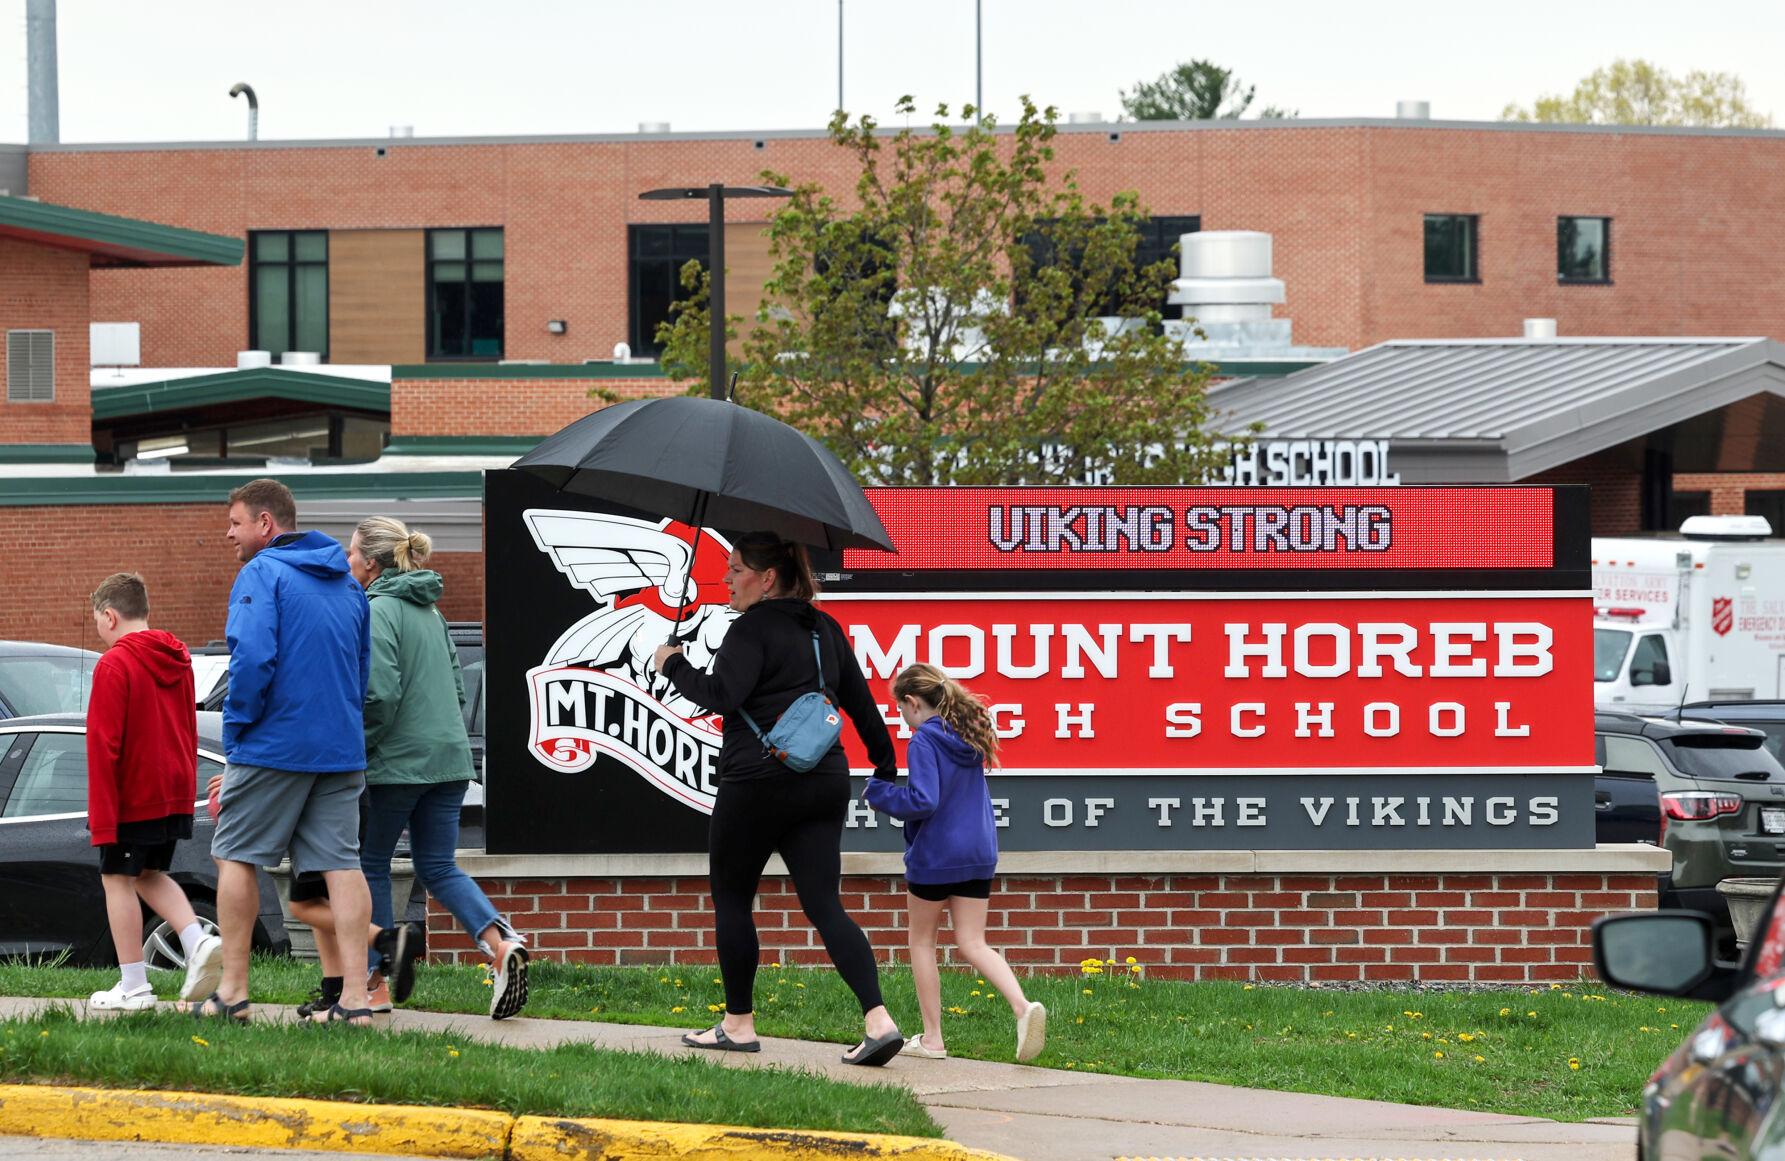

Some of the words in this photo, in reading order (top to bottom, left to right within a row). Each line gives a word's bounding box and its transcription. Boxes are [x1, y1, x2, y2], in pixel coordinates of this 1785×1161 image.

[1267, 440, 1401, 486] SCHOOL
[989, 506, 1175, 553] VIKING
[1187, 505, 1393, 552] STRONG
[1615, 588, 1669, 603] SERVICES
[849, 623, 1192, 680] MOUNT
[1224, 622, 1554, 678] HOREB
[876, 703, 1095, 739] HGH
[1165, 702, 1530, 738] SCHOOL
[845, 798, 1010, 828] HE
[1043, 798, 1115, 827] OF
[1148, 797, 1267, 827] THE
[1300, 796, 1559, 826] VIKINGS
